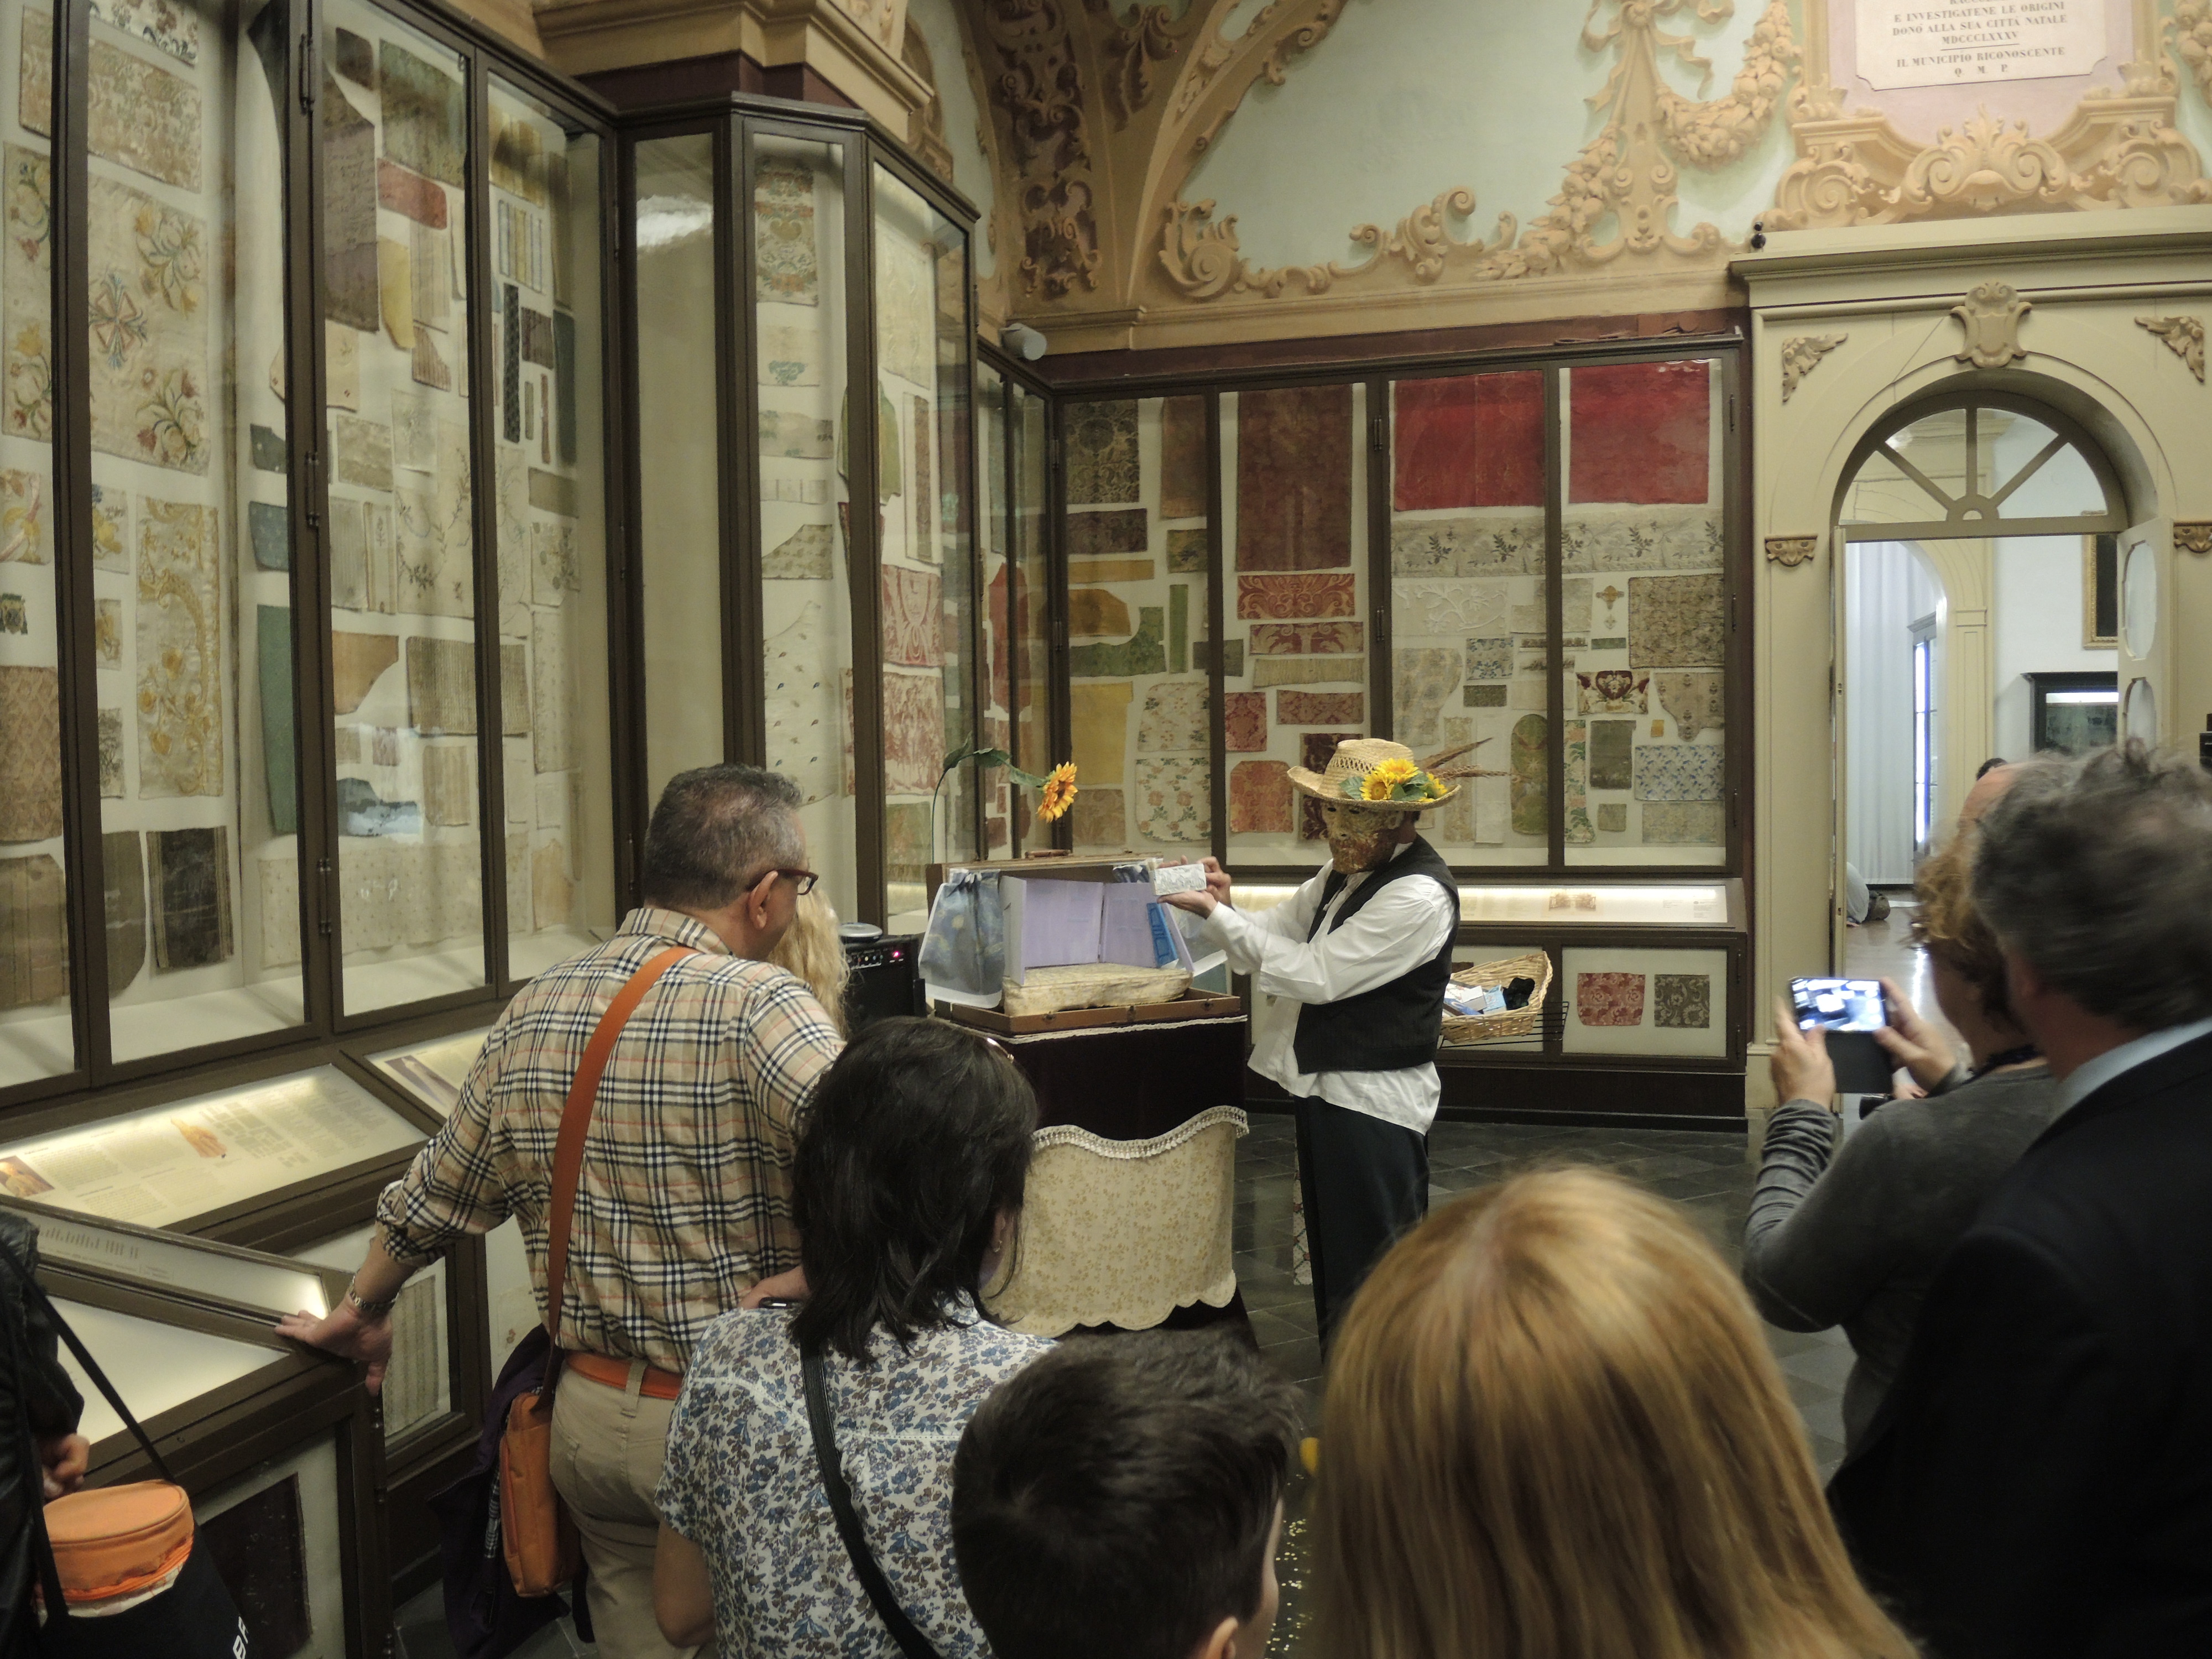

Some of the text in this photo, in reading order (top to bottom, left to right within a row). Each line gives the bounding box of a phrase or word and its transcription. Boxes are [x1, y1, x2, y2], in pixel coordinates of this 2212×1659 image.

[1895, 2, 2064, 23] E INVESTIGATENE LE ORIGINI
[1928, 24, 1955, 33] ALLA
[1960, 21, 1982, 30] SUA
[2026, 14, 2067, 25] NATALE
[1942, 31, 2018, 44] MDCCCLXXXV
[1897, 47, 2065, 67] IL MUNICIPIO RICONOSCENTE
